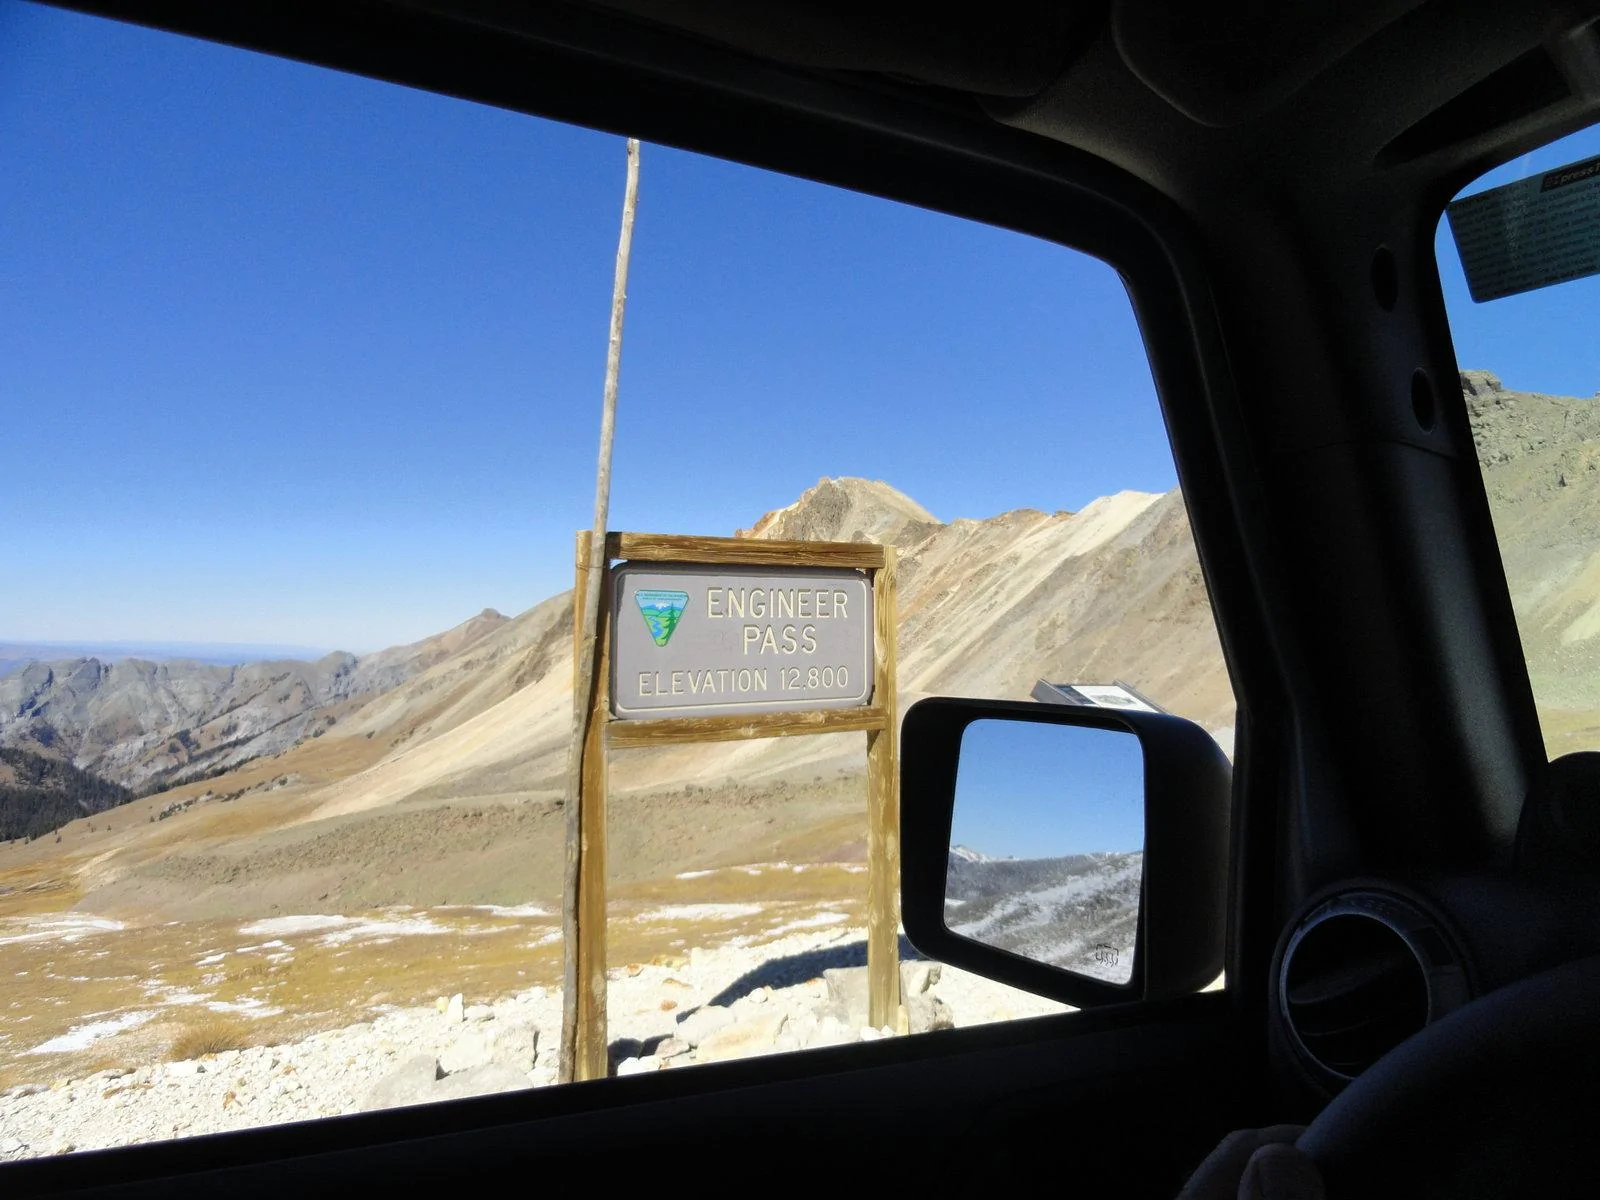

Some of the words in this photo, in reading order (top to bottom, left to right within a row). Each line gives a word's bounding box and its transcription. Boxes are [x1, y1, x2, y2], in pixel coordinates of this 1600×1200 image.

[707, 587, 848, 619] ENGINEER
[743, 624, 817, 656] PASS
[638, 668, 768, 697] ELEVATION
